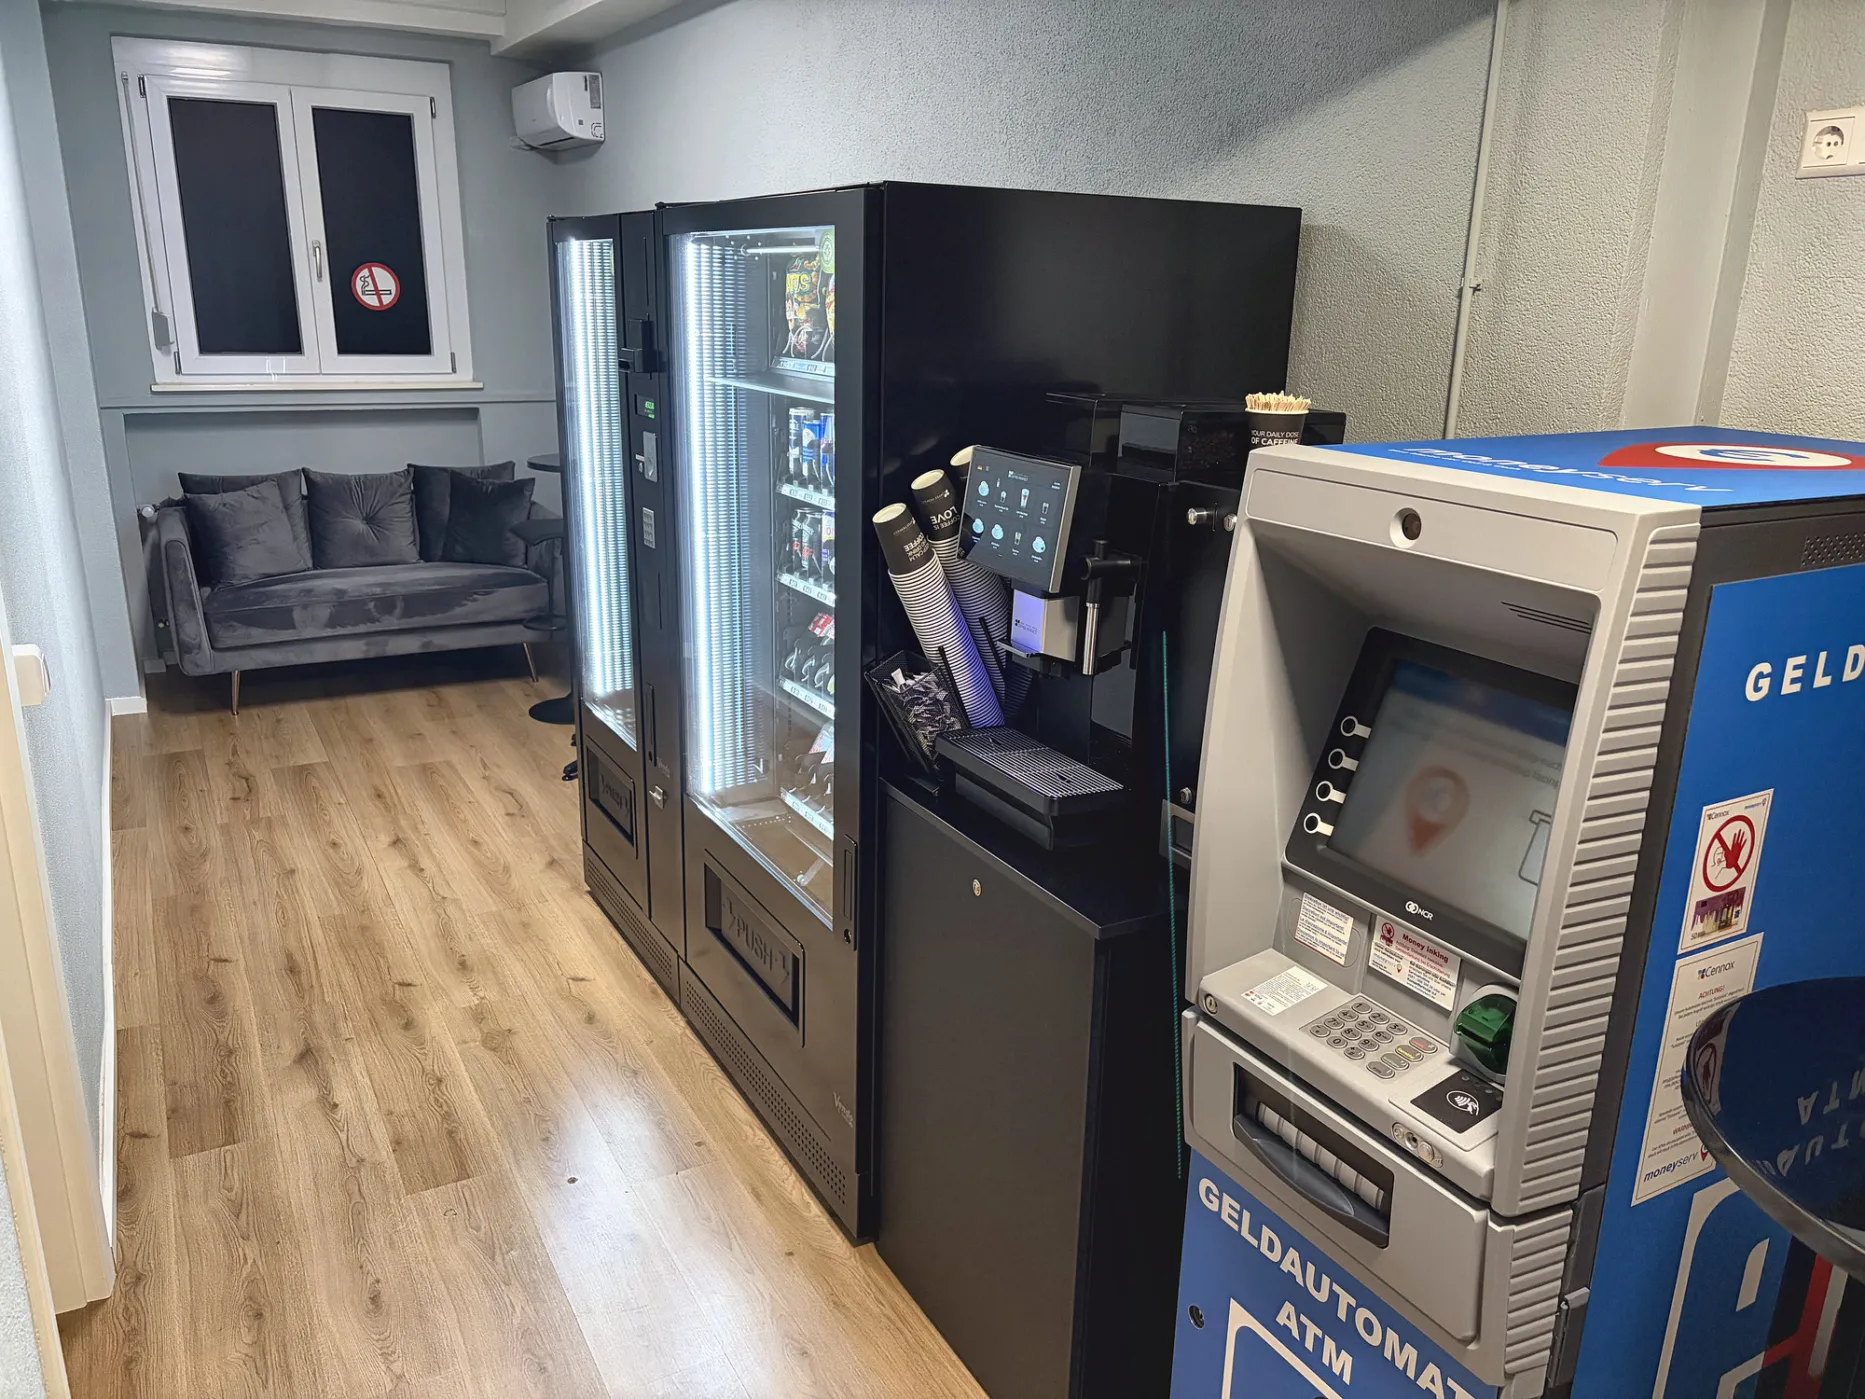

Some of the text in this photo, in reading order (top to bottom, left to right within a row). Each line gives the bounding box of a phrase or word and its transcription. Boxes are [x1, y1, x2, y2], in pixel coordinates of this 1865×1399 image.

[1251, 437, 1260, 445] OF
[929, 505, 958, 525] LOVE
[933, 523, 940, 531] IS
[908, 550, 923, 562] CALM
[1745, 644, 1865, 701] GELD
[1417, 909, 1434, 921] NCR
[737, 917, 773, 972] PUSH
[1402, 933, 1425, 951] Money
[1705, 960, 1736, 978] Cennox
[1643, 1151, 1699, 1183] moneyserv
[1275, 1301, 1354, 1386] ATM
